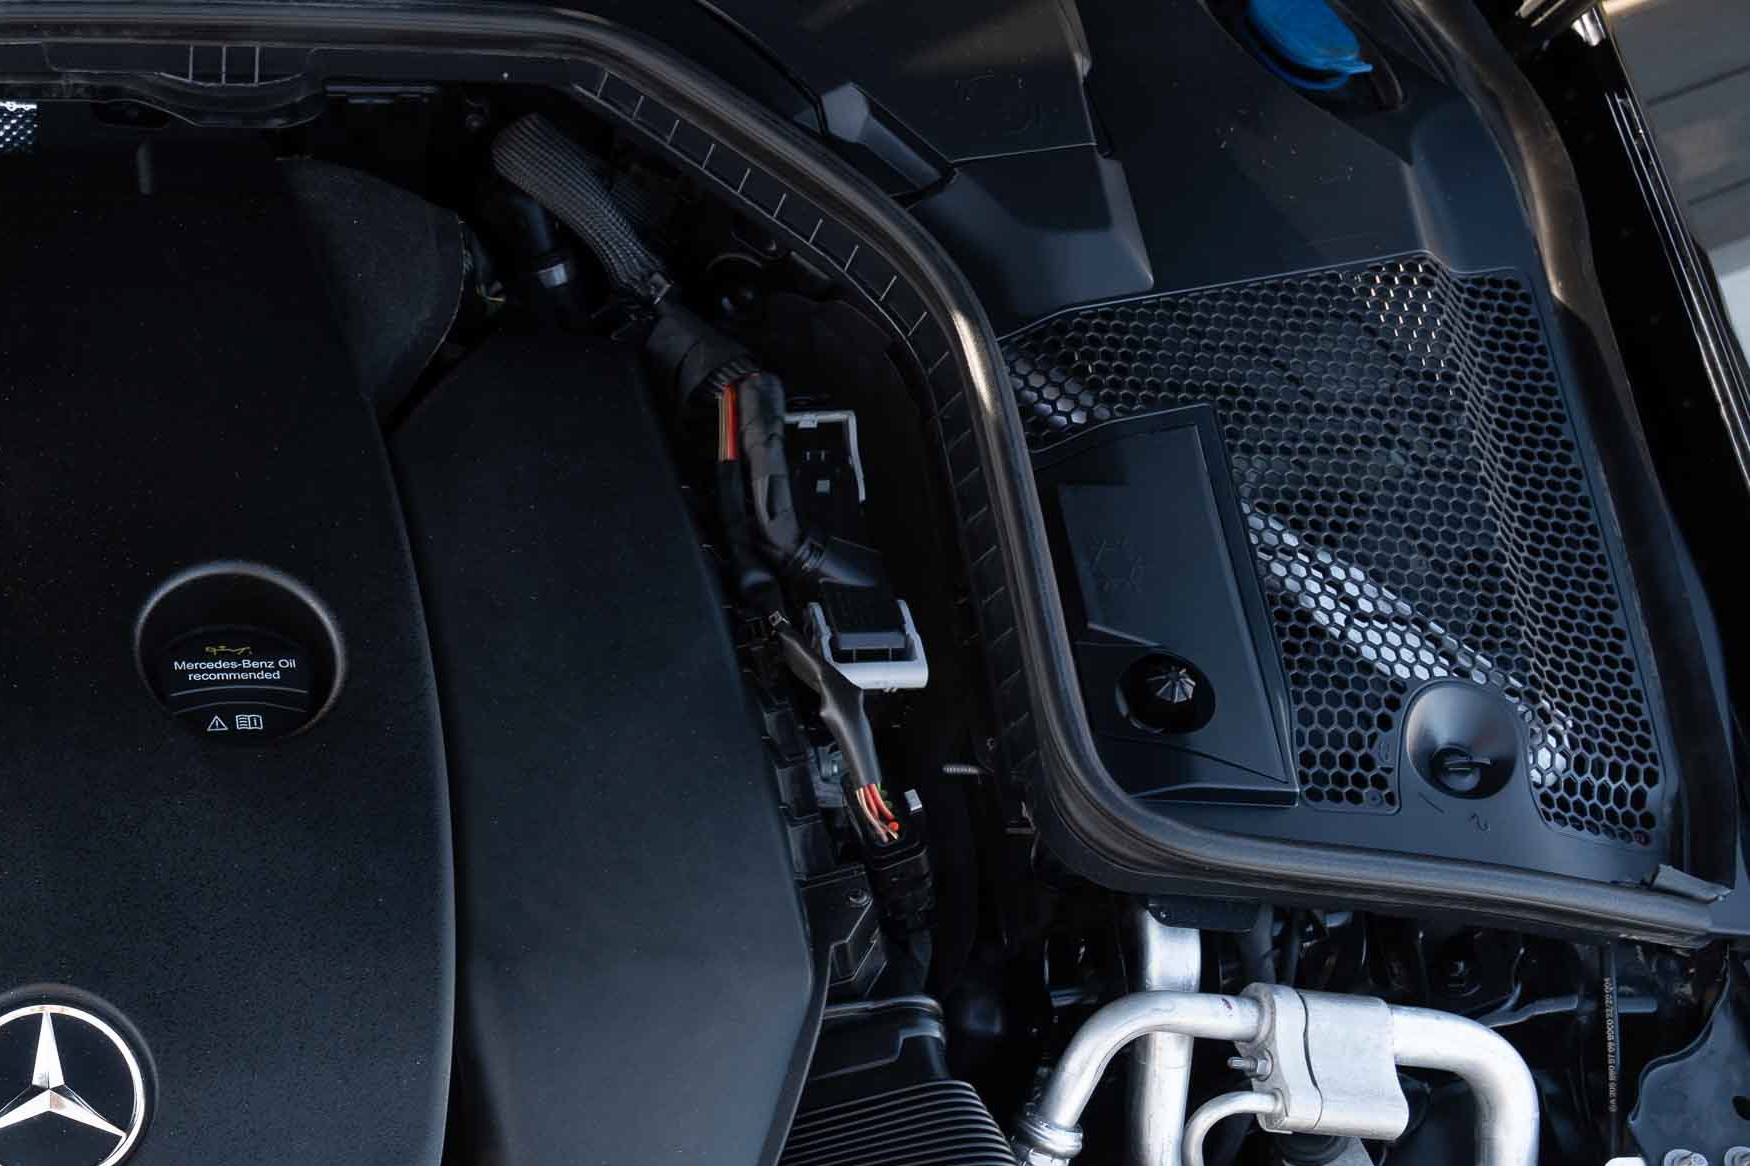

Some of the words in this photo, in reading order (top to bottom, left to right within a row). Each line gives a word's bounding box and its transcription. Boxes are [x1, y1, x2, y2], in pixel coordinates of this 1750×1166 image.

[173, 659, 275, 671] Mercedes-Benz
[278, 658, 296, 668] Oil
[188, 670, 281, 681] recommended
